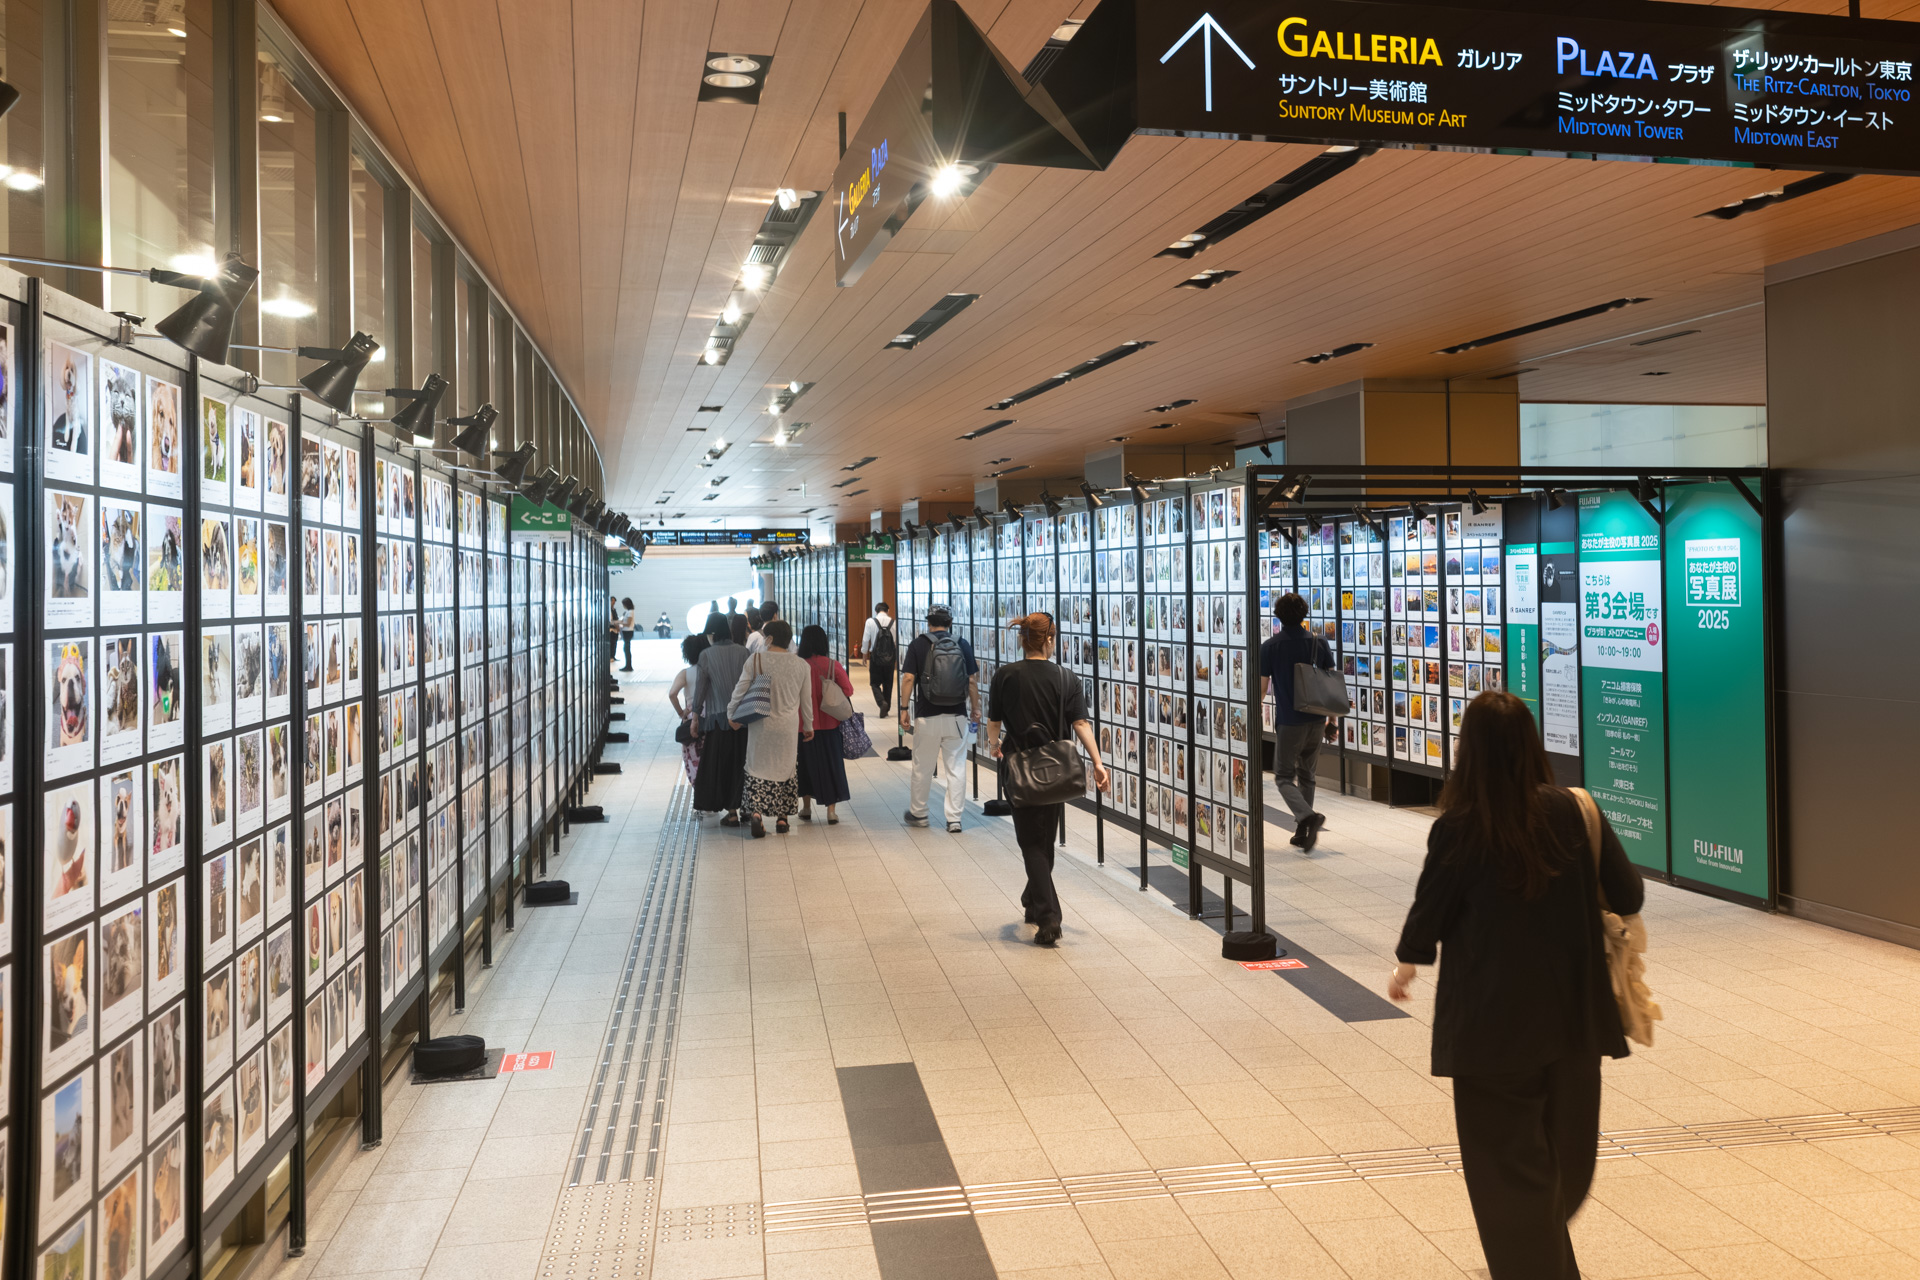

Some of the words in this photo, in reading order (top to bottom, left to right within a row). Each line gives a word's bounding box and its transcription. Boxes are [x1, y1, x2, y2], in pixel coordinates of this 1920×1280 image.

[1276, 16, 1443, 67] GALLERIA
[1456, 48, 1522, 71] ガレリア
[1556, 36, 1658, 81] PLAZA
[1733, 49, 1912, 82] ザ・リッツ・カールトン東京
[1668, 63, 1715, 85] プラザ
[1278, 74, 1428, 104] サントリー美術館
[1556, 91, 1712, 118] ミッドタウン・タワー
[1734, 102, 1894, 131] ミッドタウン・イースト
[1582, 536, 1640, 549] あなたが主役の写真展
[1641, 535, 1658, 547] 2025
[1689, 561, 1736, 574] あなたが主役の
[1585, 575, 1611, 586] こちらは
[1690, 575, 1737, 601] 写真展
[1585, 592, 1659, 621] 第3会場です
[1698, 609, 1729, 629] 2025
[1608, 628, 1643, 638] メトロアベニュー
[1601, 680, 1642, 693] アニコム損害保険
[1610, 747, 1635, 758] コールマン
[1613, 779, 1634, 791] JR東日本
[1602, 810, 1653, 829] ウス食品グループ本社
[1694, 839, 1743, 864] FUJIFILM
[1708, 859, 1718, 868] from
